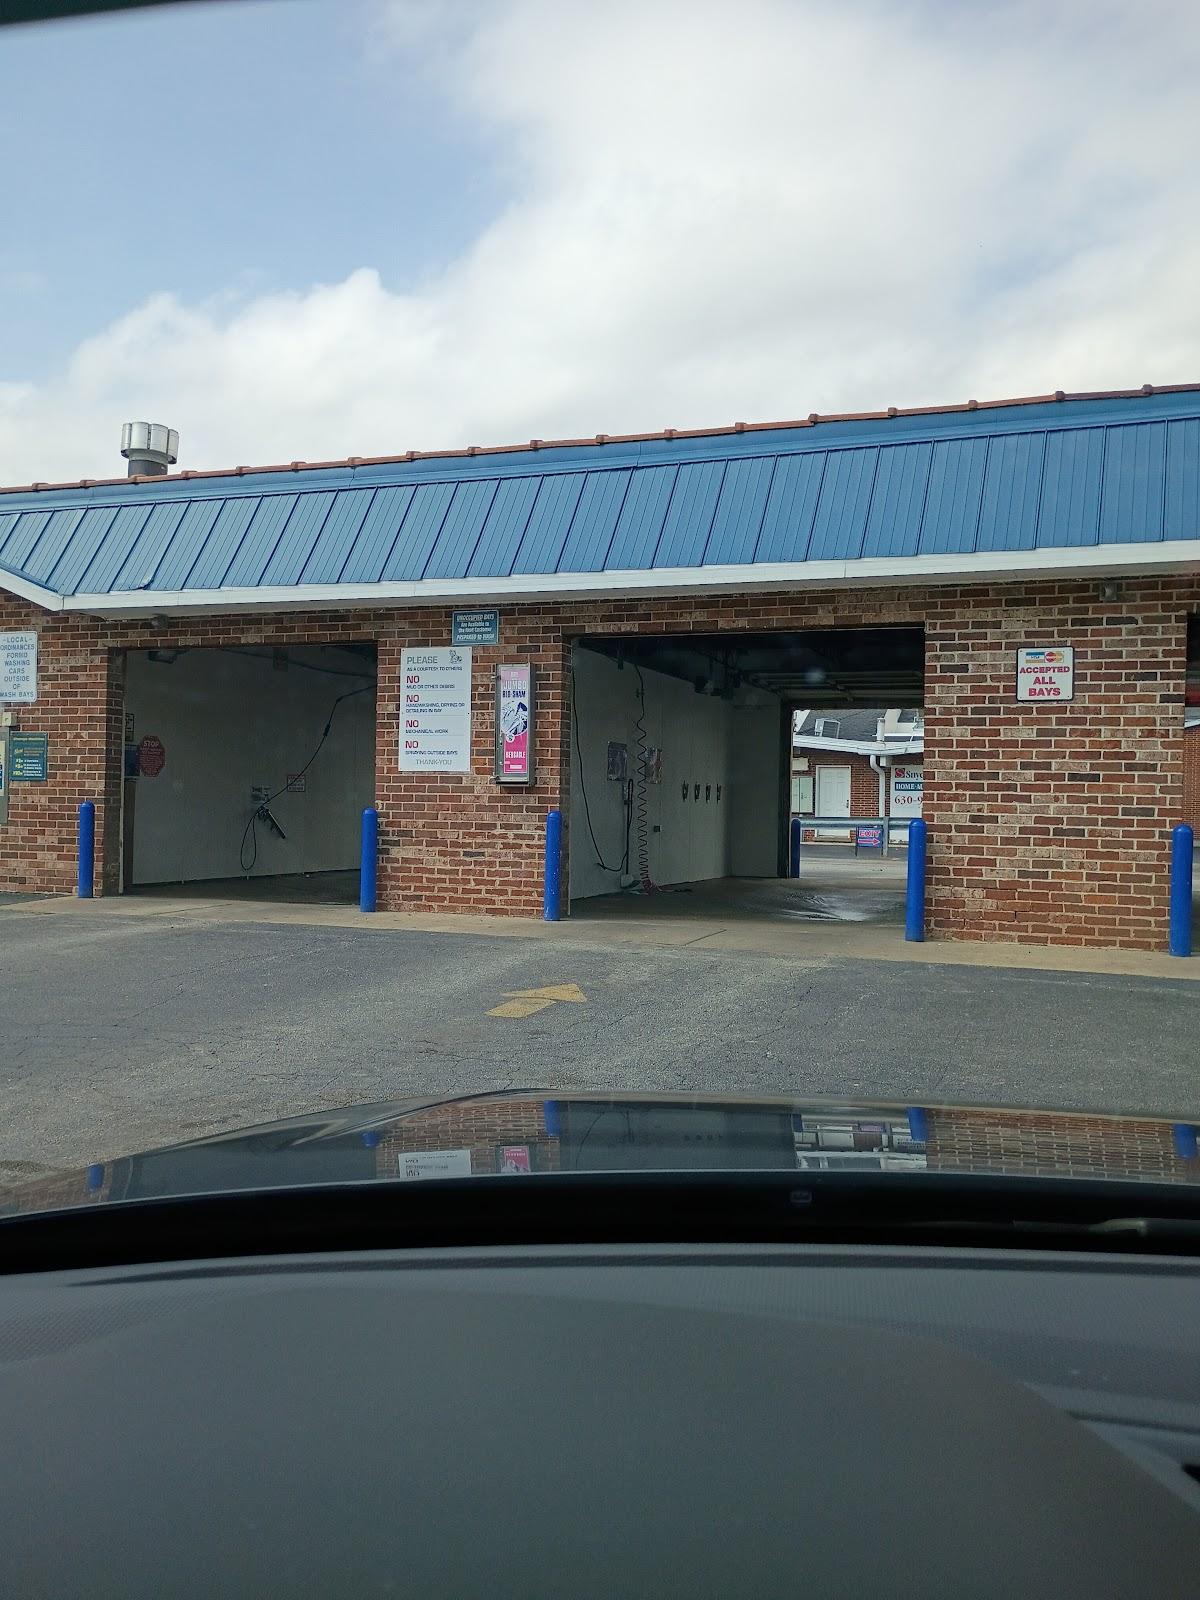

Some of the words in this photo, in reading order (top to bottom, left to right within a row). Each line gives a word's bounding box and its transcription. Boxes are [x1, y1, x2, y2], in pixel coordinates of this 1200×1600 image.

[407, 656, 438, 664] PLEASE
[406, 675, 420, 684] NO
[1033, 676, 1056, 685] ALL
[503, 680, 527, 690] JUMBO
[1028, 687, 1061, 696] BAYS
[406, 694, 420, 703] NO
[405, 720, 419, 728] NO
[143, 740, 160, 748] STOP
[405, 740, 419, 749] NO
[859, 829, 881, 838] EXIT
